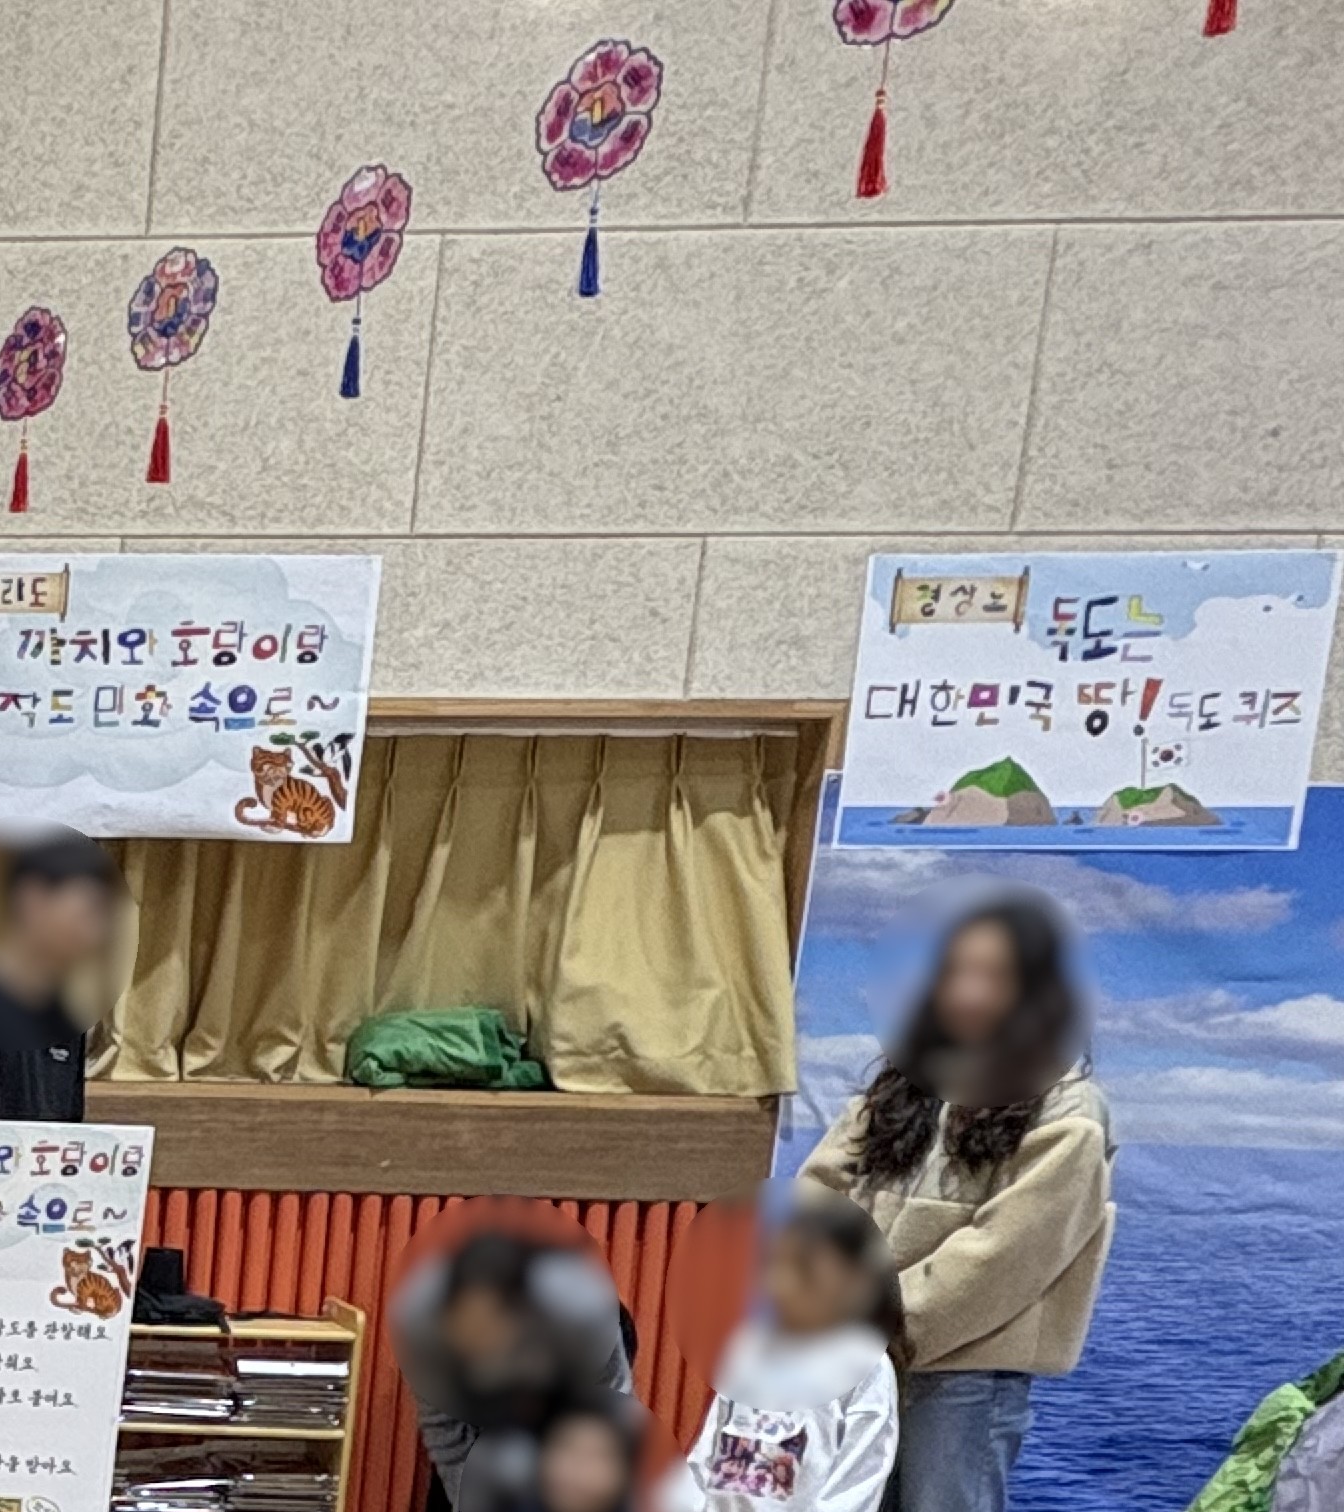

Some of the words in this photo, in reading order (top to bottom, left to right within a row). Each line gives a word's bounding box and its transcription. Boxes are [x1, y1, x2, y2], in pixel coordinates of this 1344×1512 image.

[17, 627, 159, 666] 까치와
[170, 620, 330, 667] 호랑이랑
[1047, 595, 1164, 662] 독도는
[92, 684, 173, 728] 민화
[865, 677, 1054, 733] 대한민국
[1076, 676, 1164, 738] 땅!
[1165, 690, 1224, 731] 독도
[1232, 688, 1303, 729] 퀴즈
[29, 1139, 146, 1177] 호랑이랑
